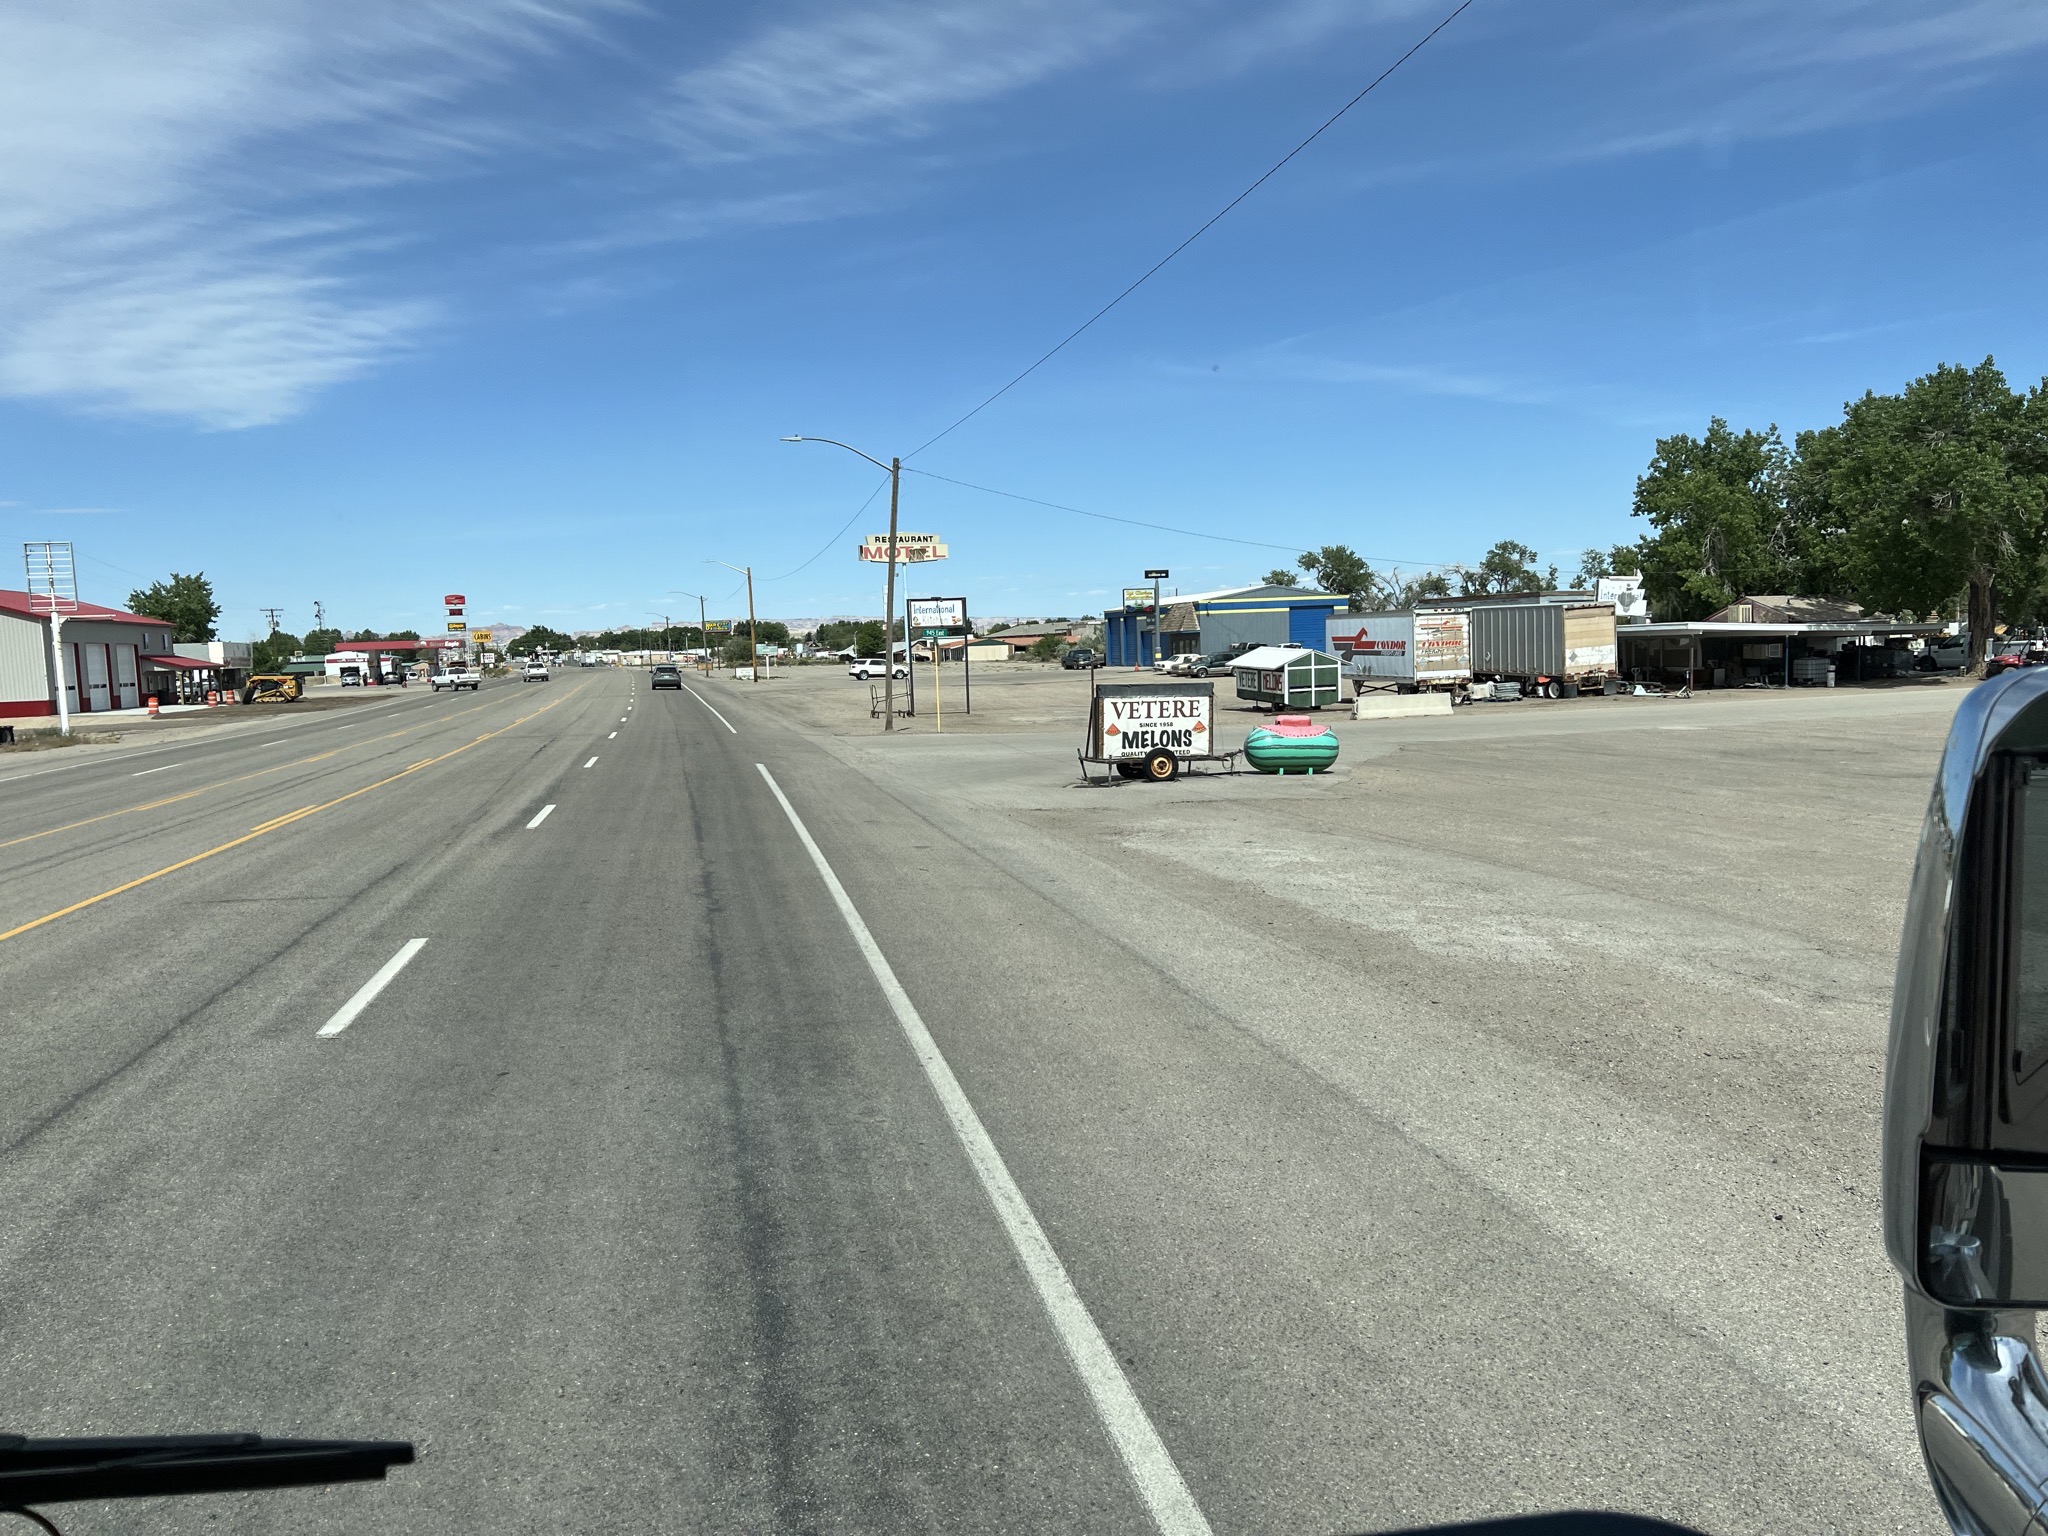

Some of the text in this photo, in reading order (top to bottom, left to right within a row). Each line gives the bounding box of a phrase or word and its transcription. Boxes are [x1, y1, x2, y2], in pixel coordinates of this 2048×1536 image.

[913, 604, 955, 614] International
[1376, 640, 1407, 650] CONDOR
[1111, 700, 1201, 719] VETERE
[1121, 729, 1193, 749] MELONS
